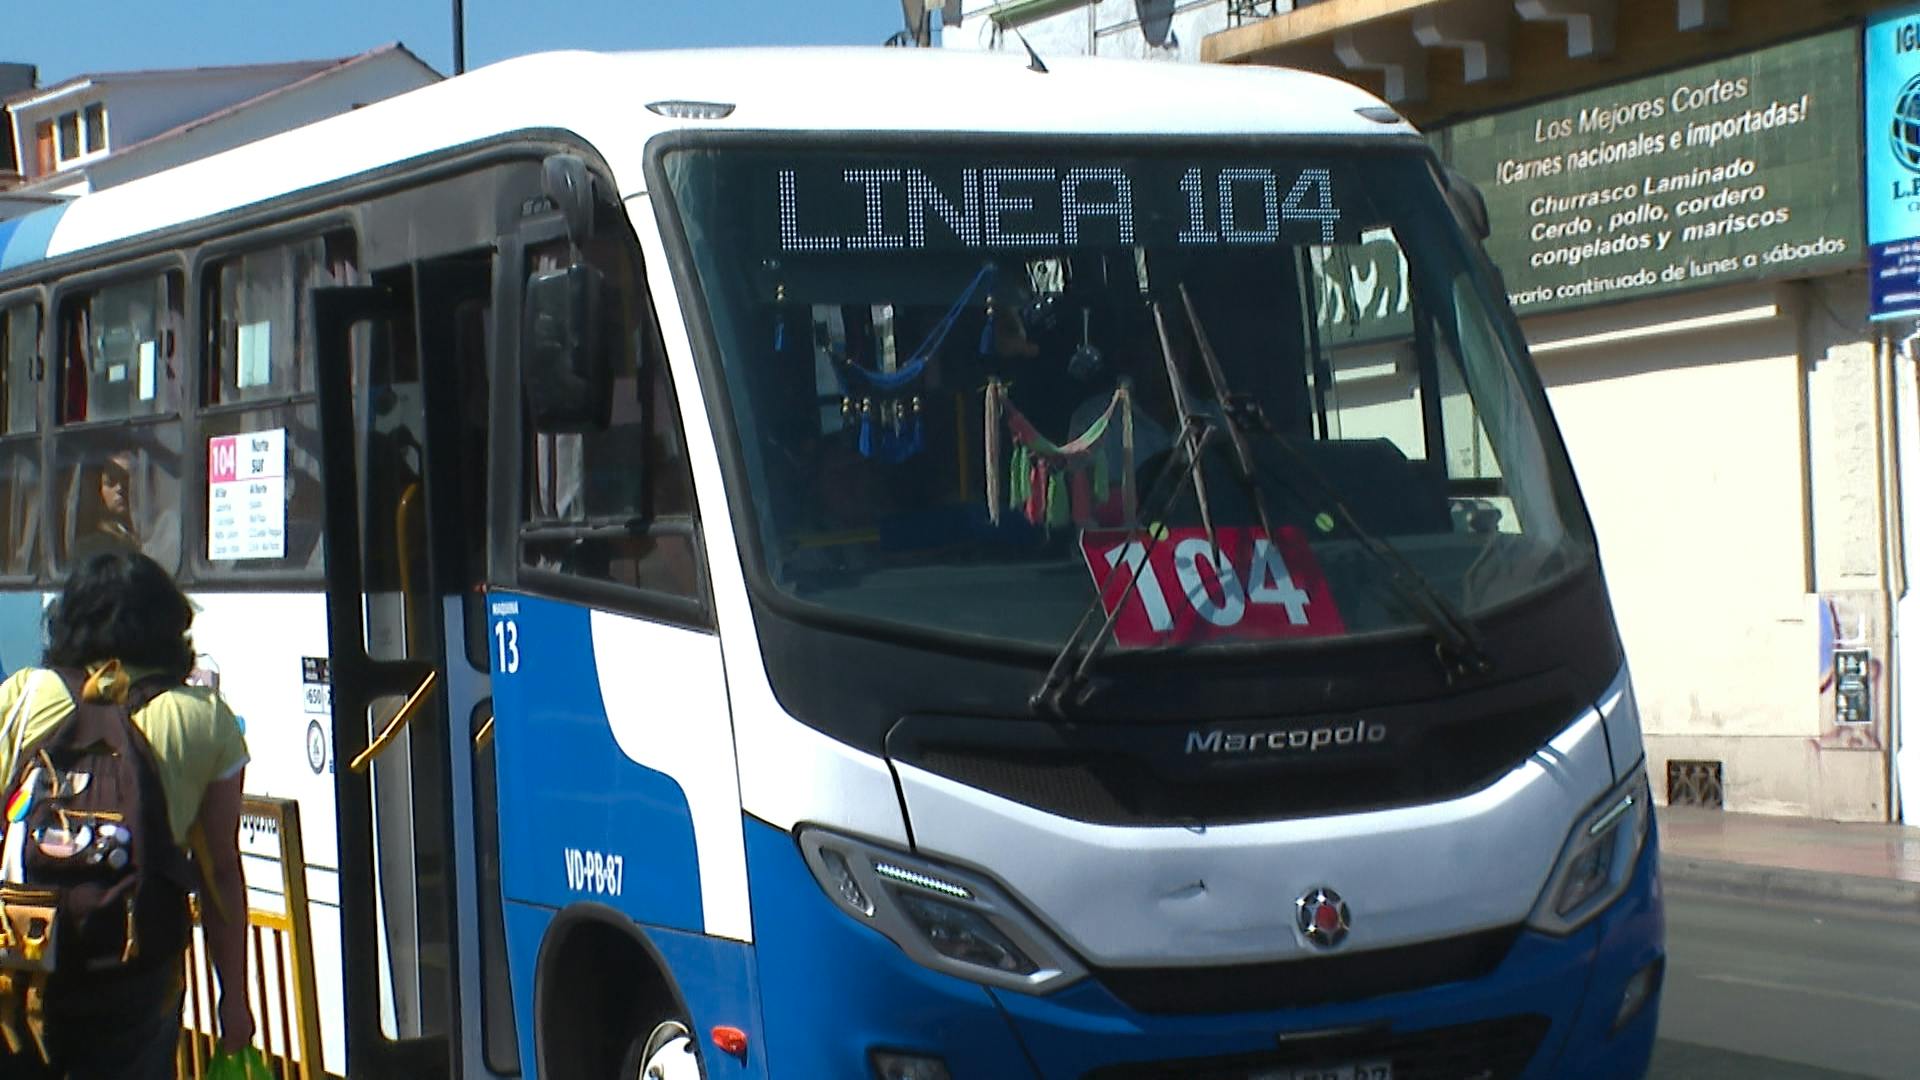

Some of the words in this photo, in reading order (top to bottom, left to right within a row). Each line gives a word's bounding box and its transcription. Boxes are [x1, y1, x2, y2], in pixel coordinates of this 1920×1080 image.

[1535, 118, 1573, 143] Los
[1578, 96, 1664, 134] Mejores
[1671, 77, 1749, 113] Cortes
[1567, 132, 1665, 171] nacionales
[1669, 130, 1682, 150] e
[1686, 94, 1810, 148] importadas!
[778, 167, 1136, 250] LINEA
[1177, 168, 1341, 245] 104
[1530, 184, 1638, 218] Churrasco
[1643, 157, 1757, 197] Laminado
[1530, 216, 1592, 243] Cerdo
[1608, 203, 1670, 234] pollo,
[1675, 184, 1766, 217] cordero
[1530, 233, 1652, 268] congelados
[1655, 230, 1673, 251] y
[1681, 206, 1791, 243] mariscos
[1556, 268, 1657, 299] continuado
[1660, 264, 1686, 284] de
[1689, 255, 1739, 278] lunes
[1742, 254, 1759, 268] a
[1762, 236, 1847, 264] sábados
[213, 445, 235, 477] 104
[1104, 538, 1310, 632] 104
[495, 620, 519, 674] 13
[1185, 720, 1387, 755] Marcopolo
